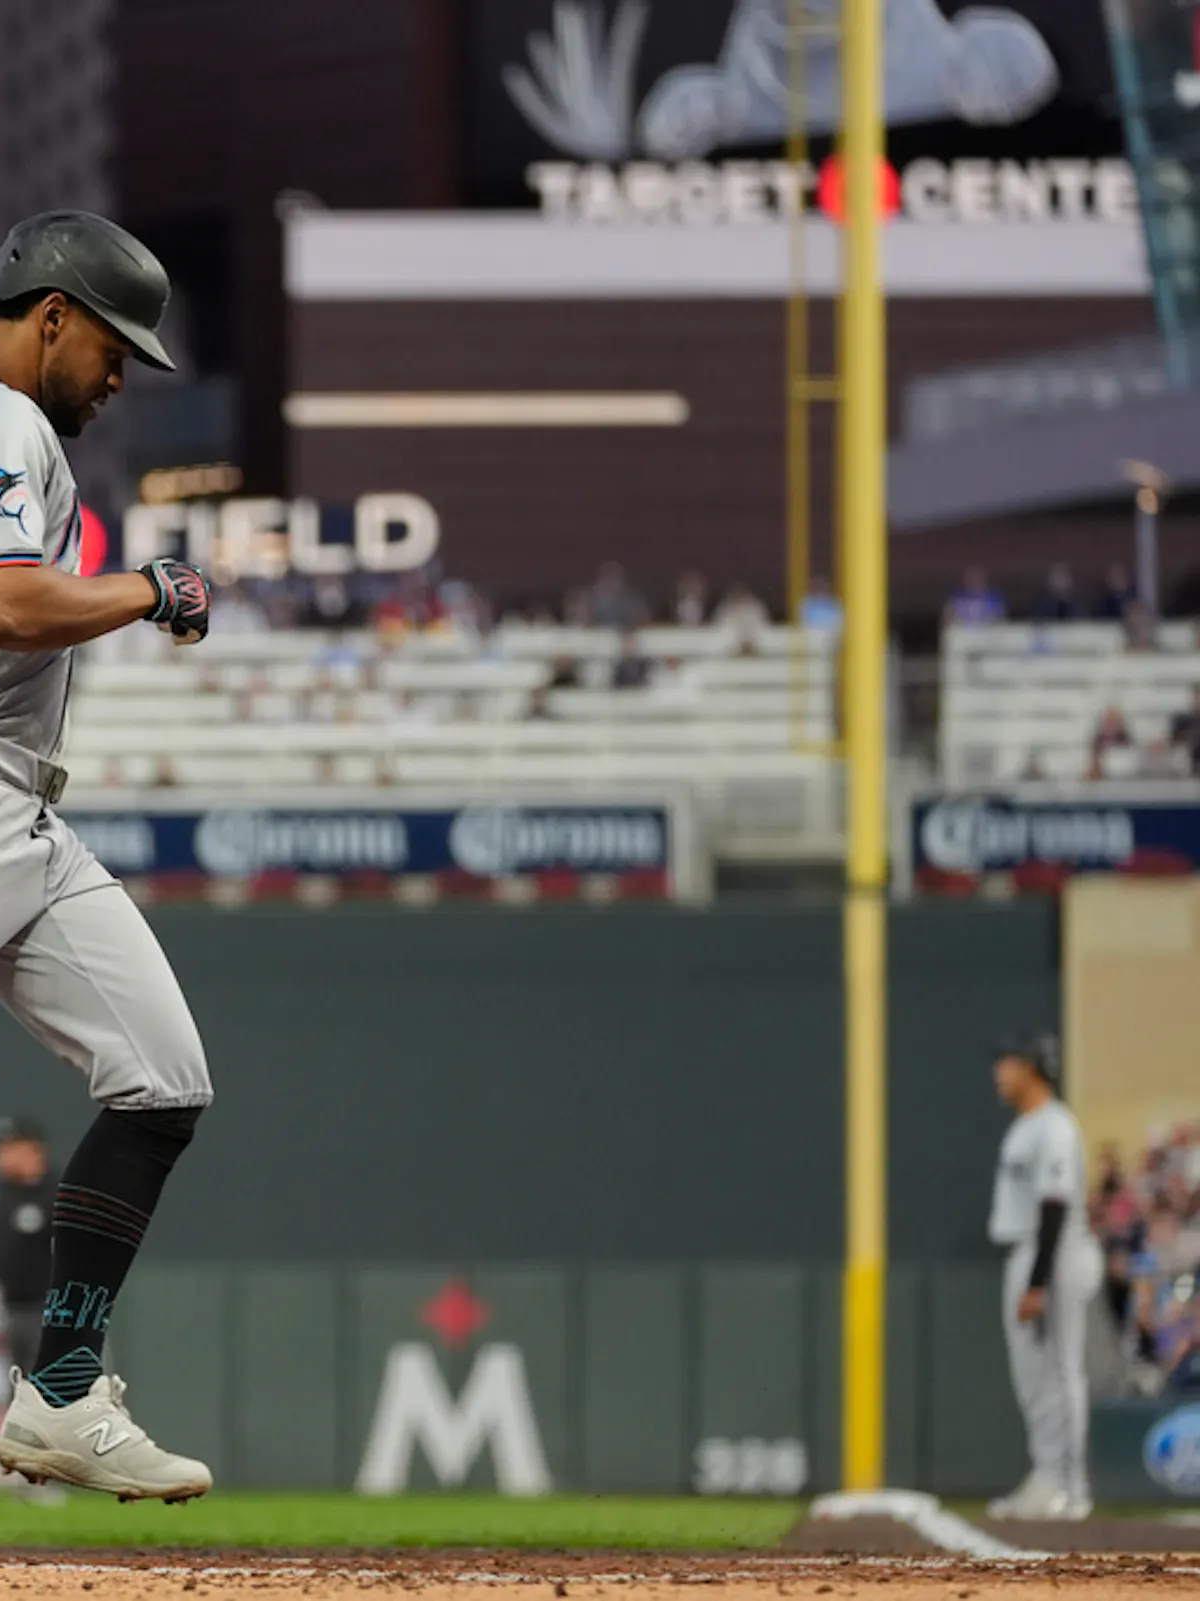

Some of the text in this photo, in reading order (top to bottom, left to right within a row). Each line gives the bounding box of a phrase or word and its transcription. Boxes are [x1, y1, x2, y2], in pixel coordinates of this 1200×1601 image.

[525, 158, 1138, 222] TARGET CENTE
[123, 492, 440, 580] FIELD
[355, 1341, 553, 1496] M
